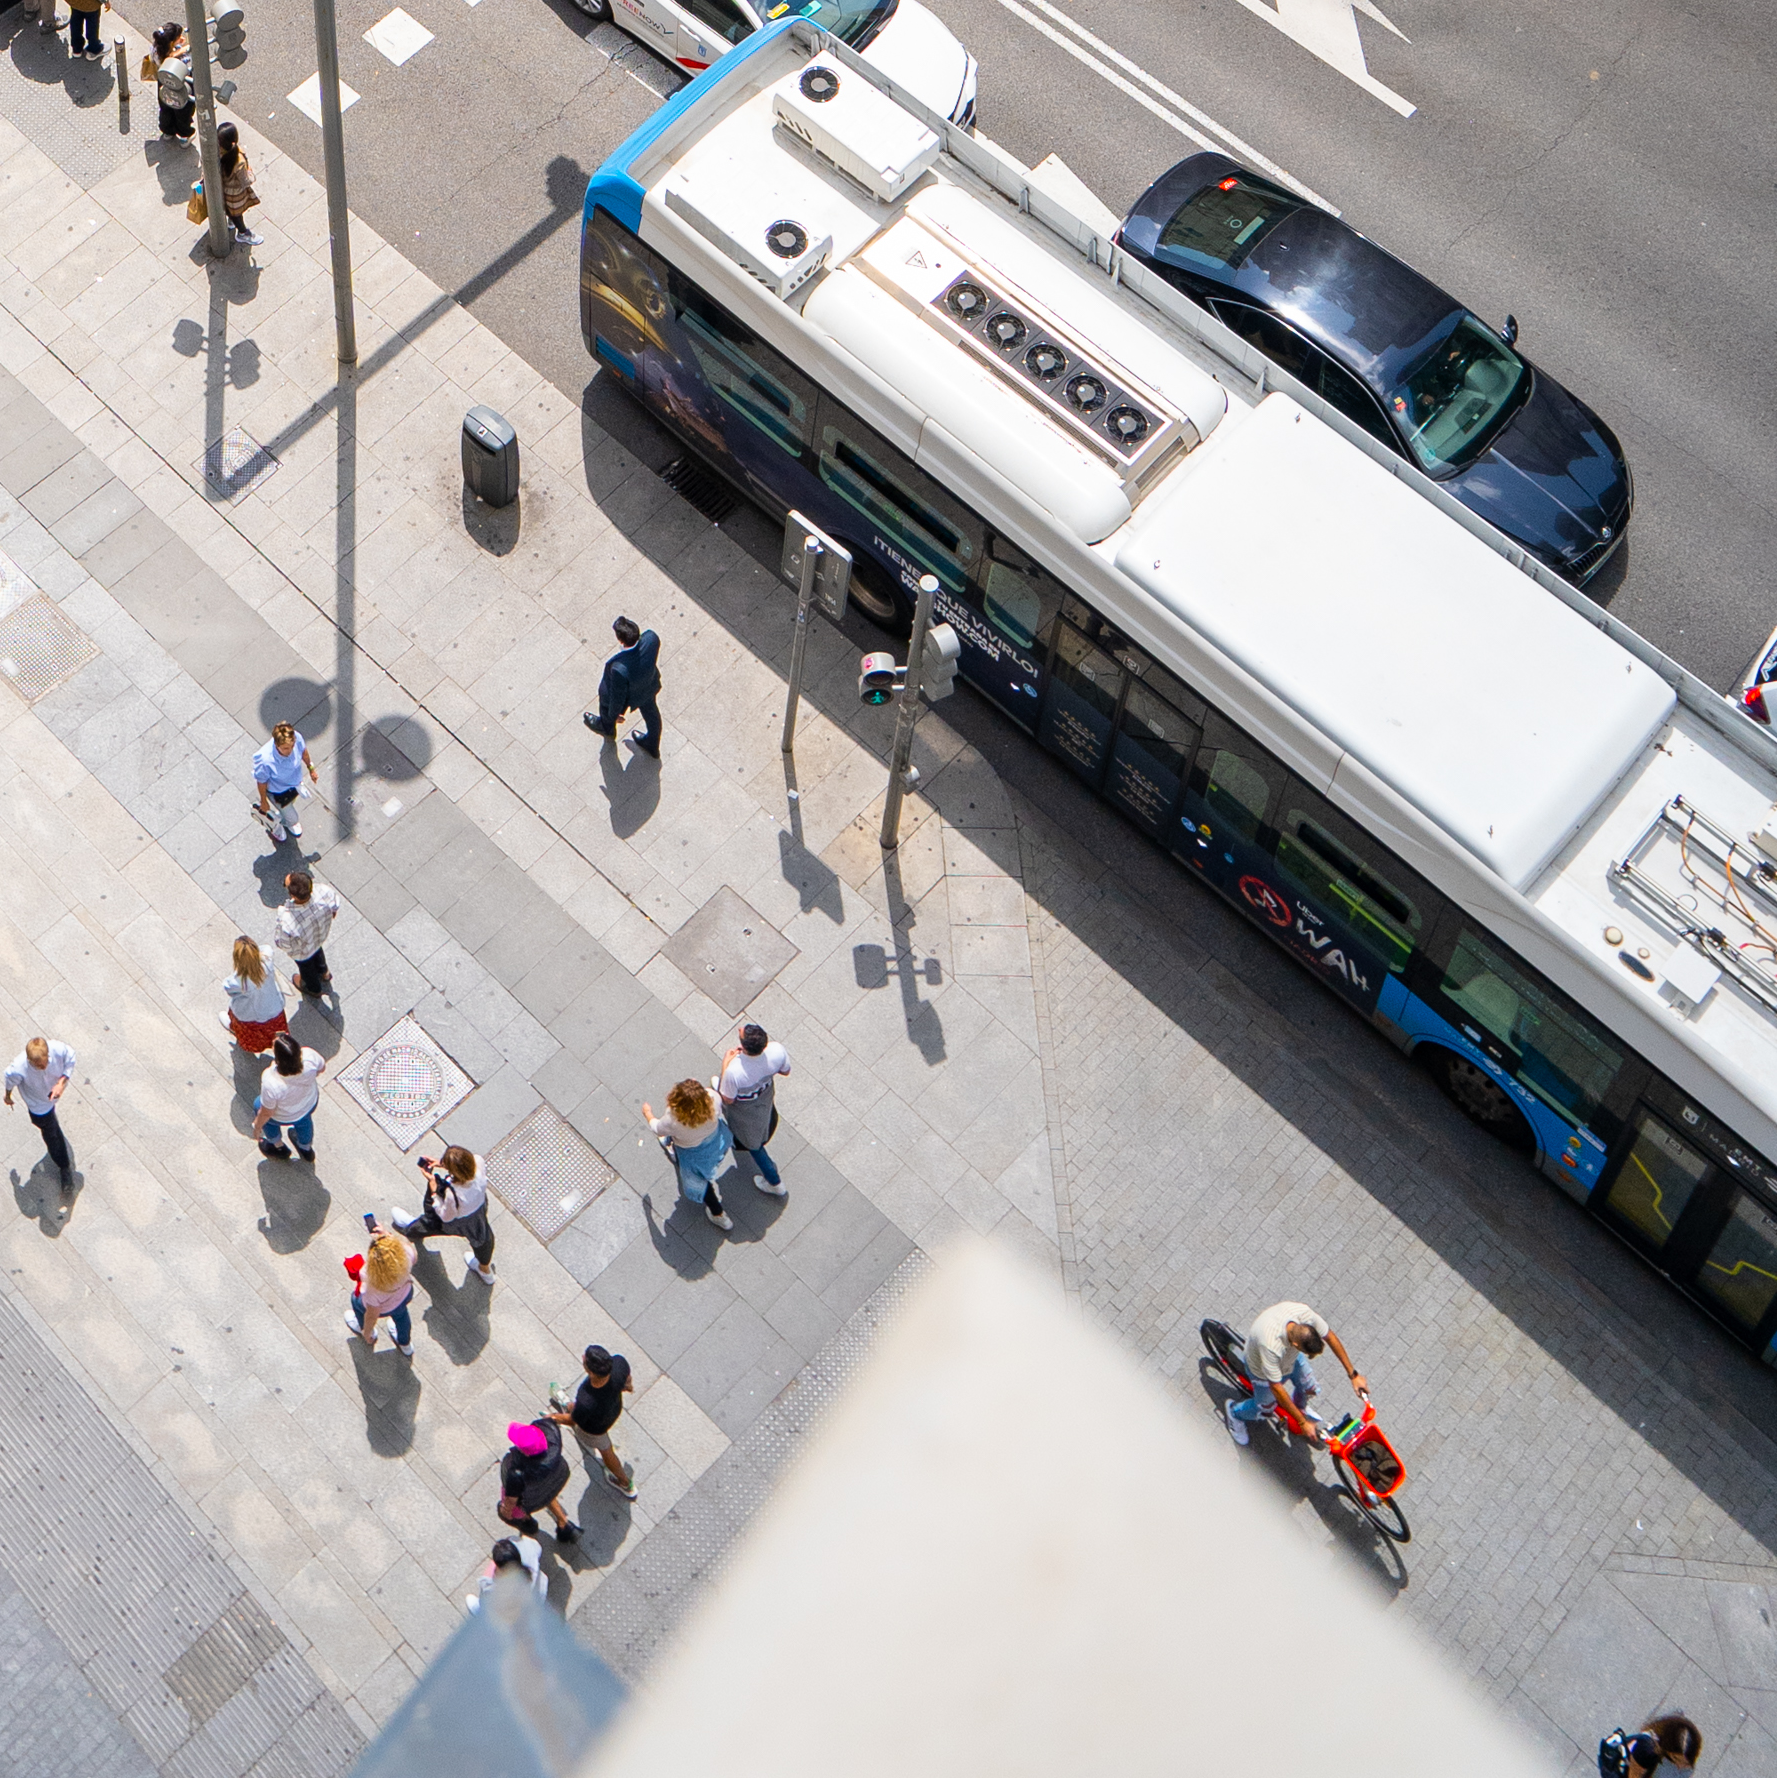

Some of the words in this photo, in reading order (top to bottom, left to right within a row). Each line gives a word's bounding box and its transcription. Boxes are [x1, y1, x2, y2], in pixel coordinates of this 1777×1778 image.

[874, 533, 921, 583] ¡TIENE
[938, 587, 969, 622] QUE
[971, 614, 1038, 681] VIVIRLO!
